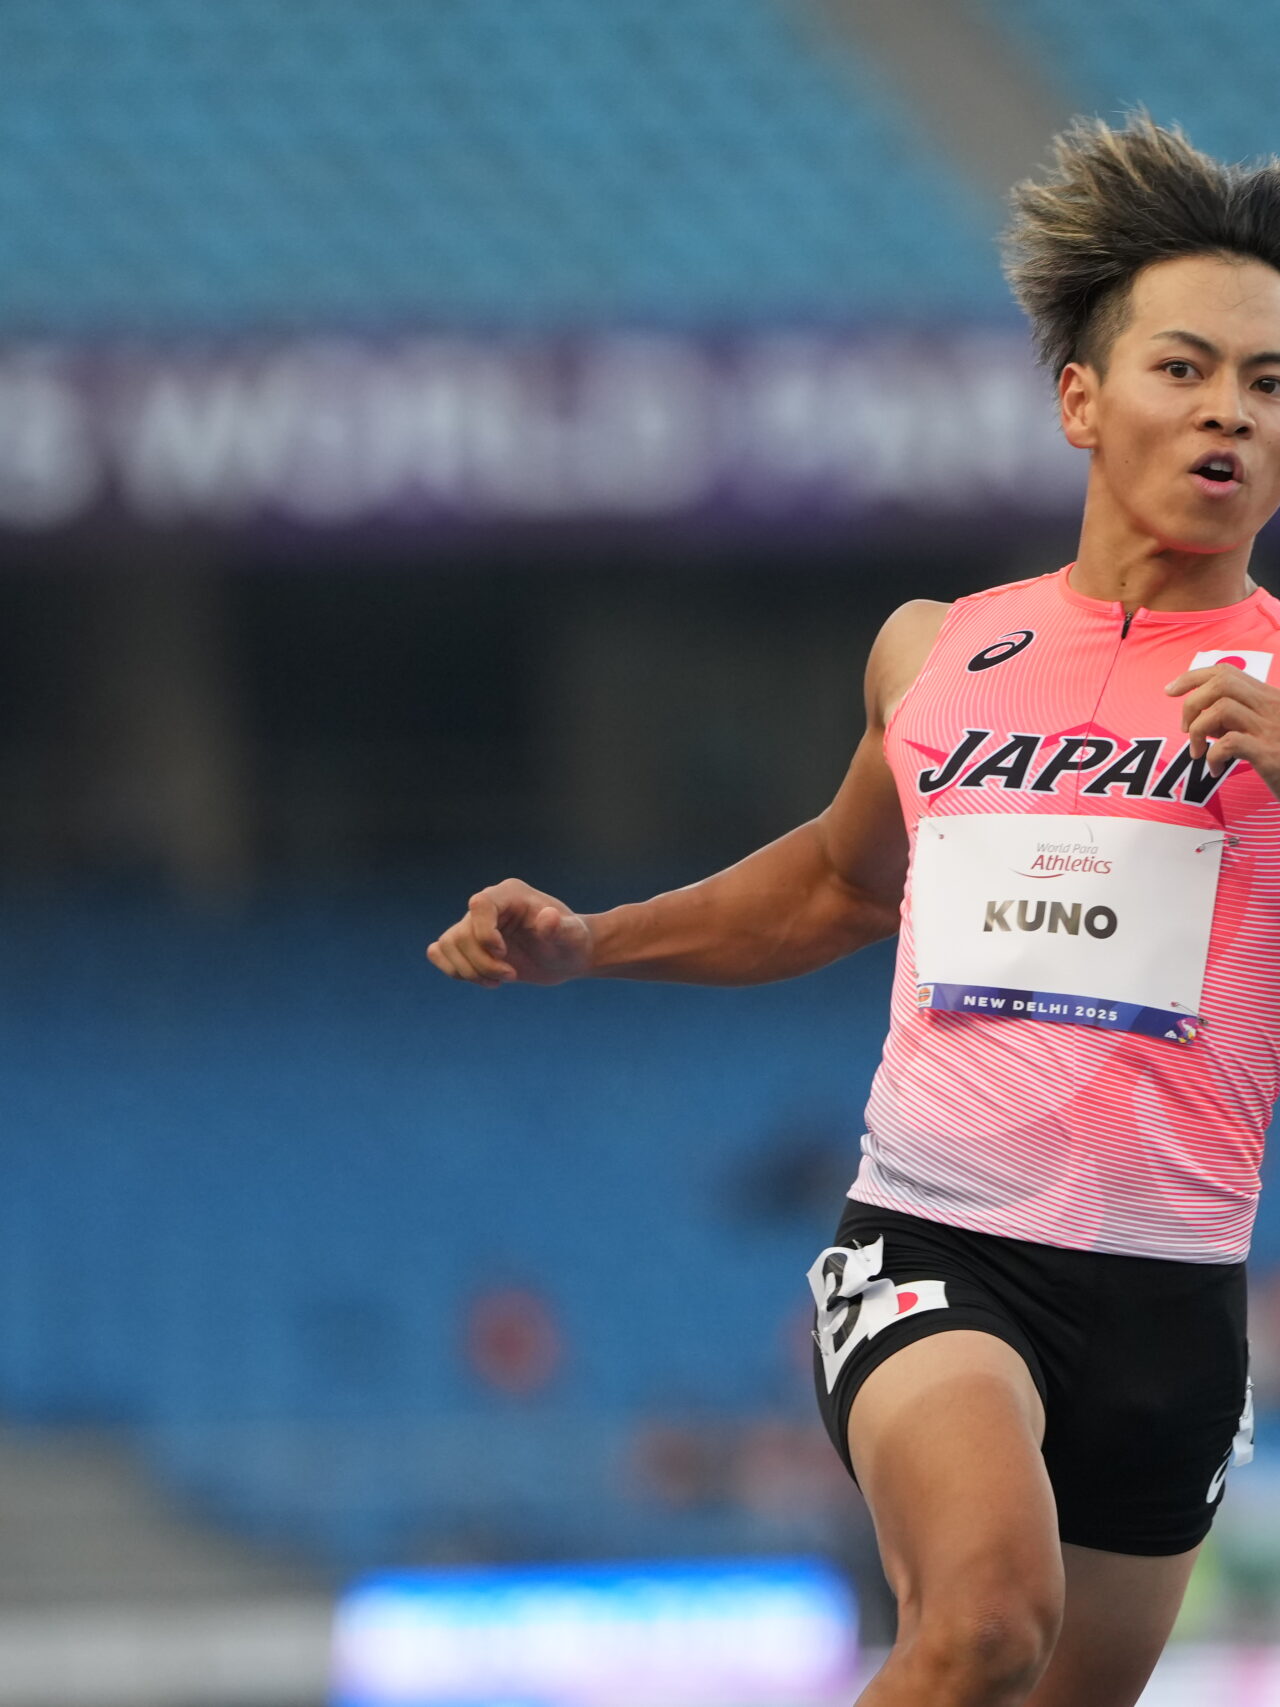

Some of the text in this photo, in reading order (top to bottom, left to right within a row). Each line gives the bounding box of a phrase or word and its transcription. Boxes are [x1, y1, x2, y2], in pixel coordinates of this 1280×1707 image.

[918, 729, 1240, 807] JAPAN
[1036, 842, 1099, 855] World Para
[1030, 854, 1113, 875] Athletics
[982, 899, 1118, 940] KUNO
[963, 995, 1118, 1021] NEW DELHI 2025
